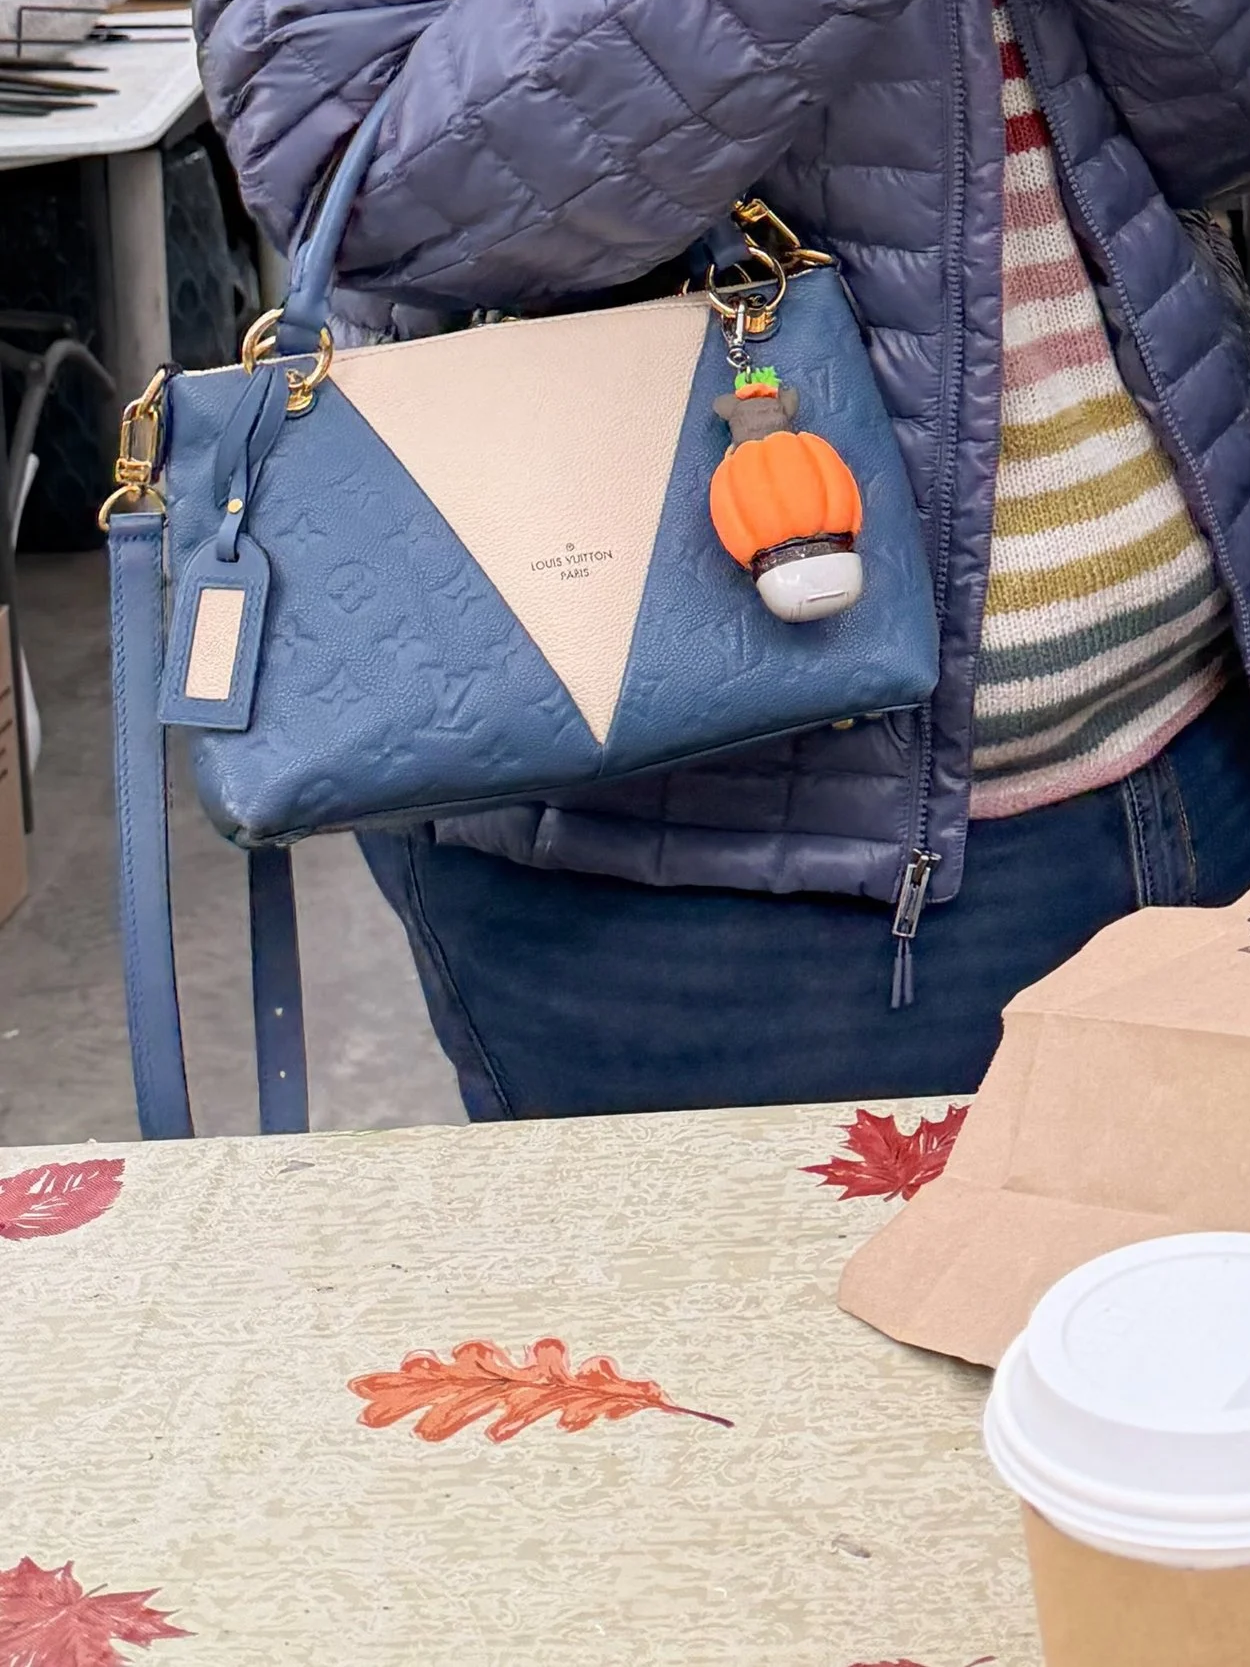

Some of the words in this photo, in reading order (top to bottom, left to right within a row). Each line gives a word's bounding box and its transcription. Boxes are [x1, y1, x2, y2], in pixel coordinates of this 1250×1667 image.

[530, 558, 563, 572] LOUIS
[565, 549, 614, 565] VUITTON
[560, 568, 590, 581] PARIS
